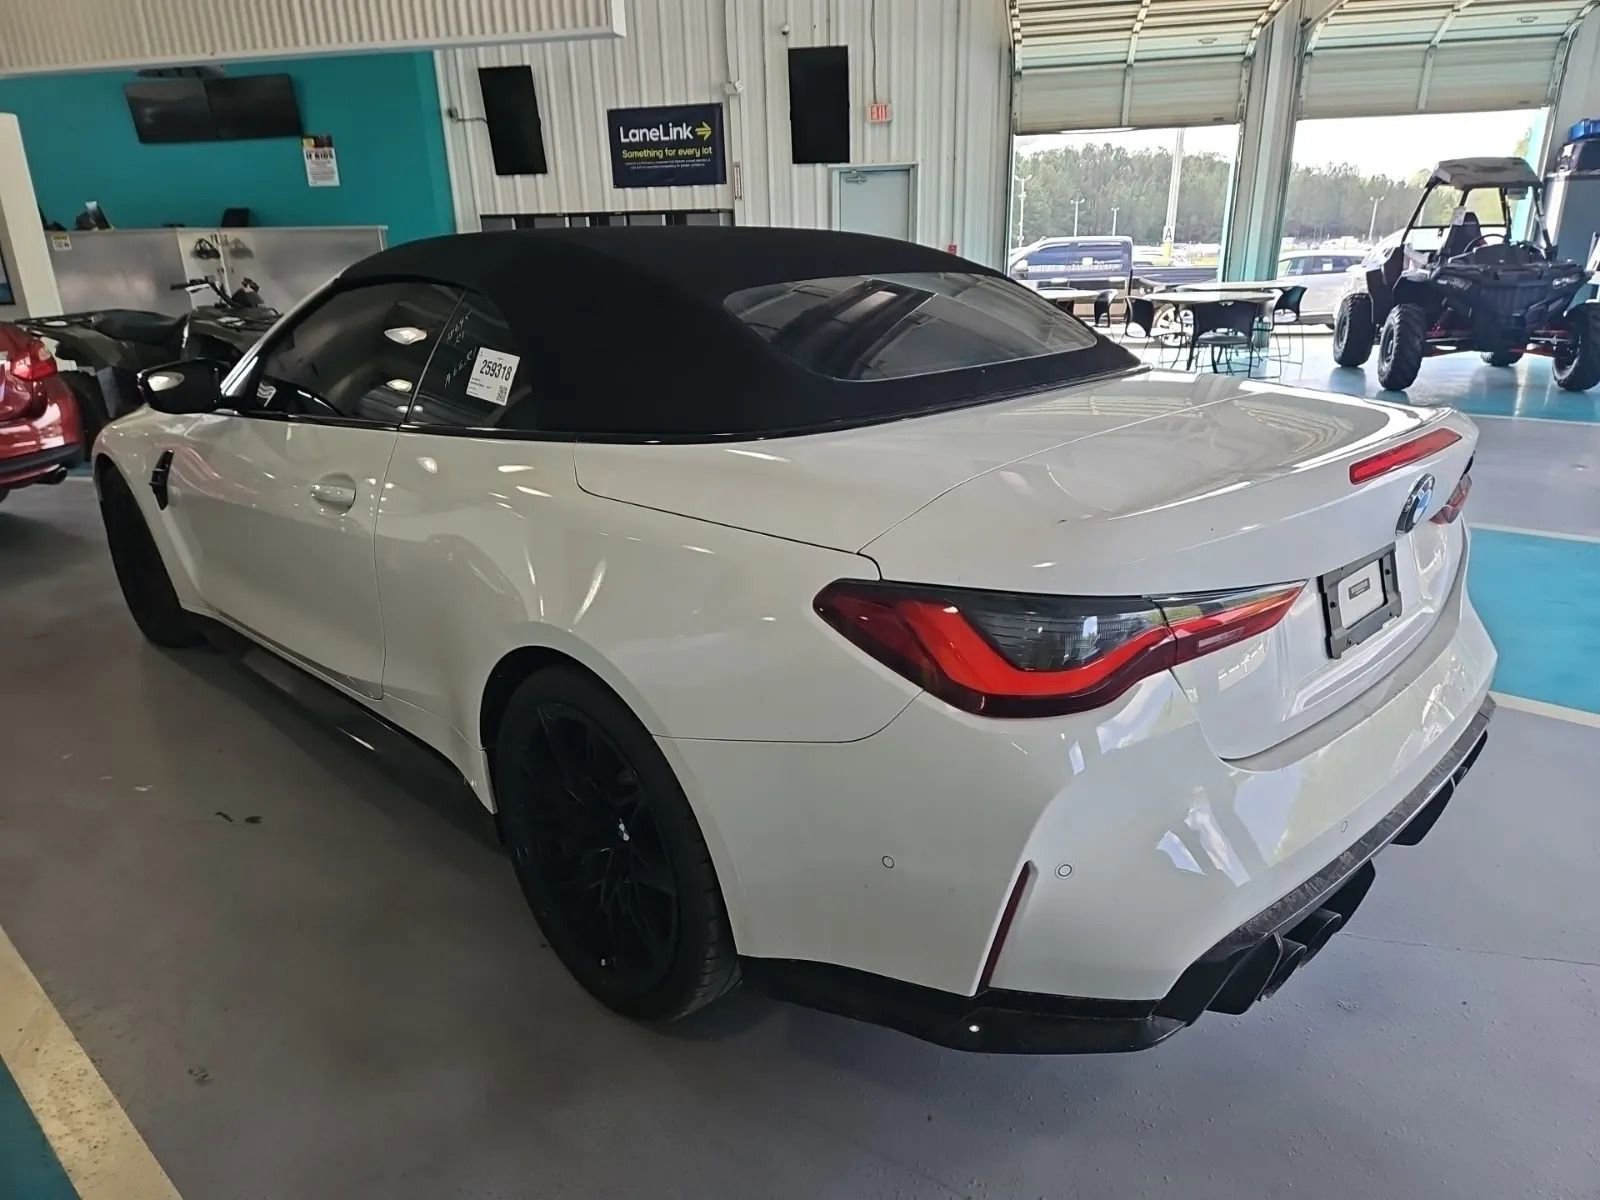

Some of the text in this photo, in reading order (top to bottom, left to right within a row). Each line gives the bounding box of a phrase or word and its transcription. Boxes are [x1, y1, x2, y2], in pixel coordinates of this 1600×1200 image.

[871, 105, 889, 120] EXIT
[620, 122, 694, 143] LaneLink
[622, 146, 713, 159] Something for every lot
[480, 359, 513, 382] 259318
